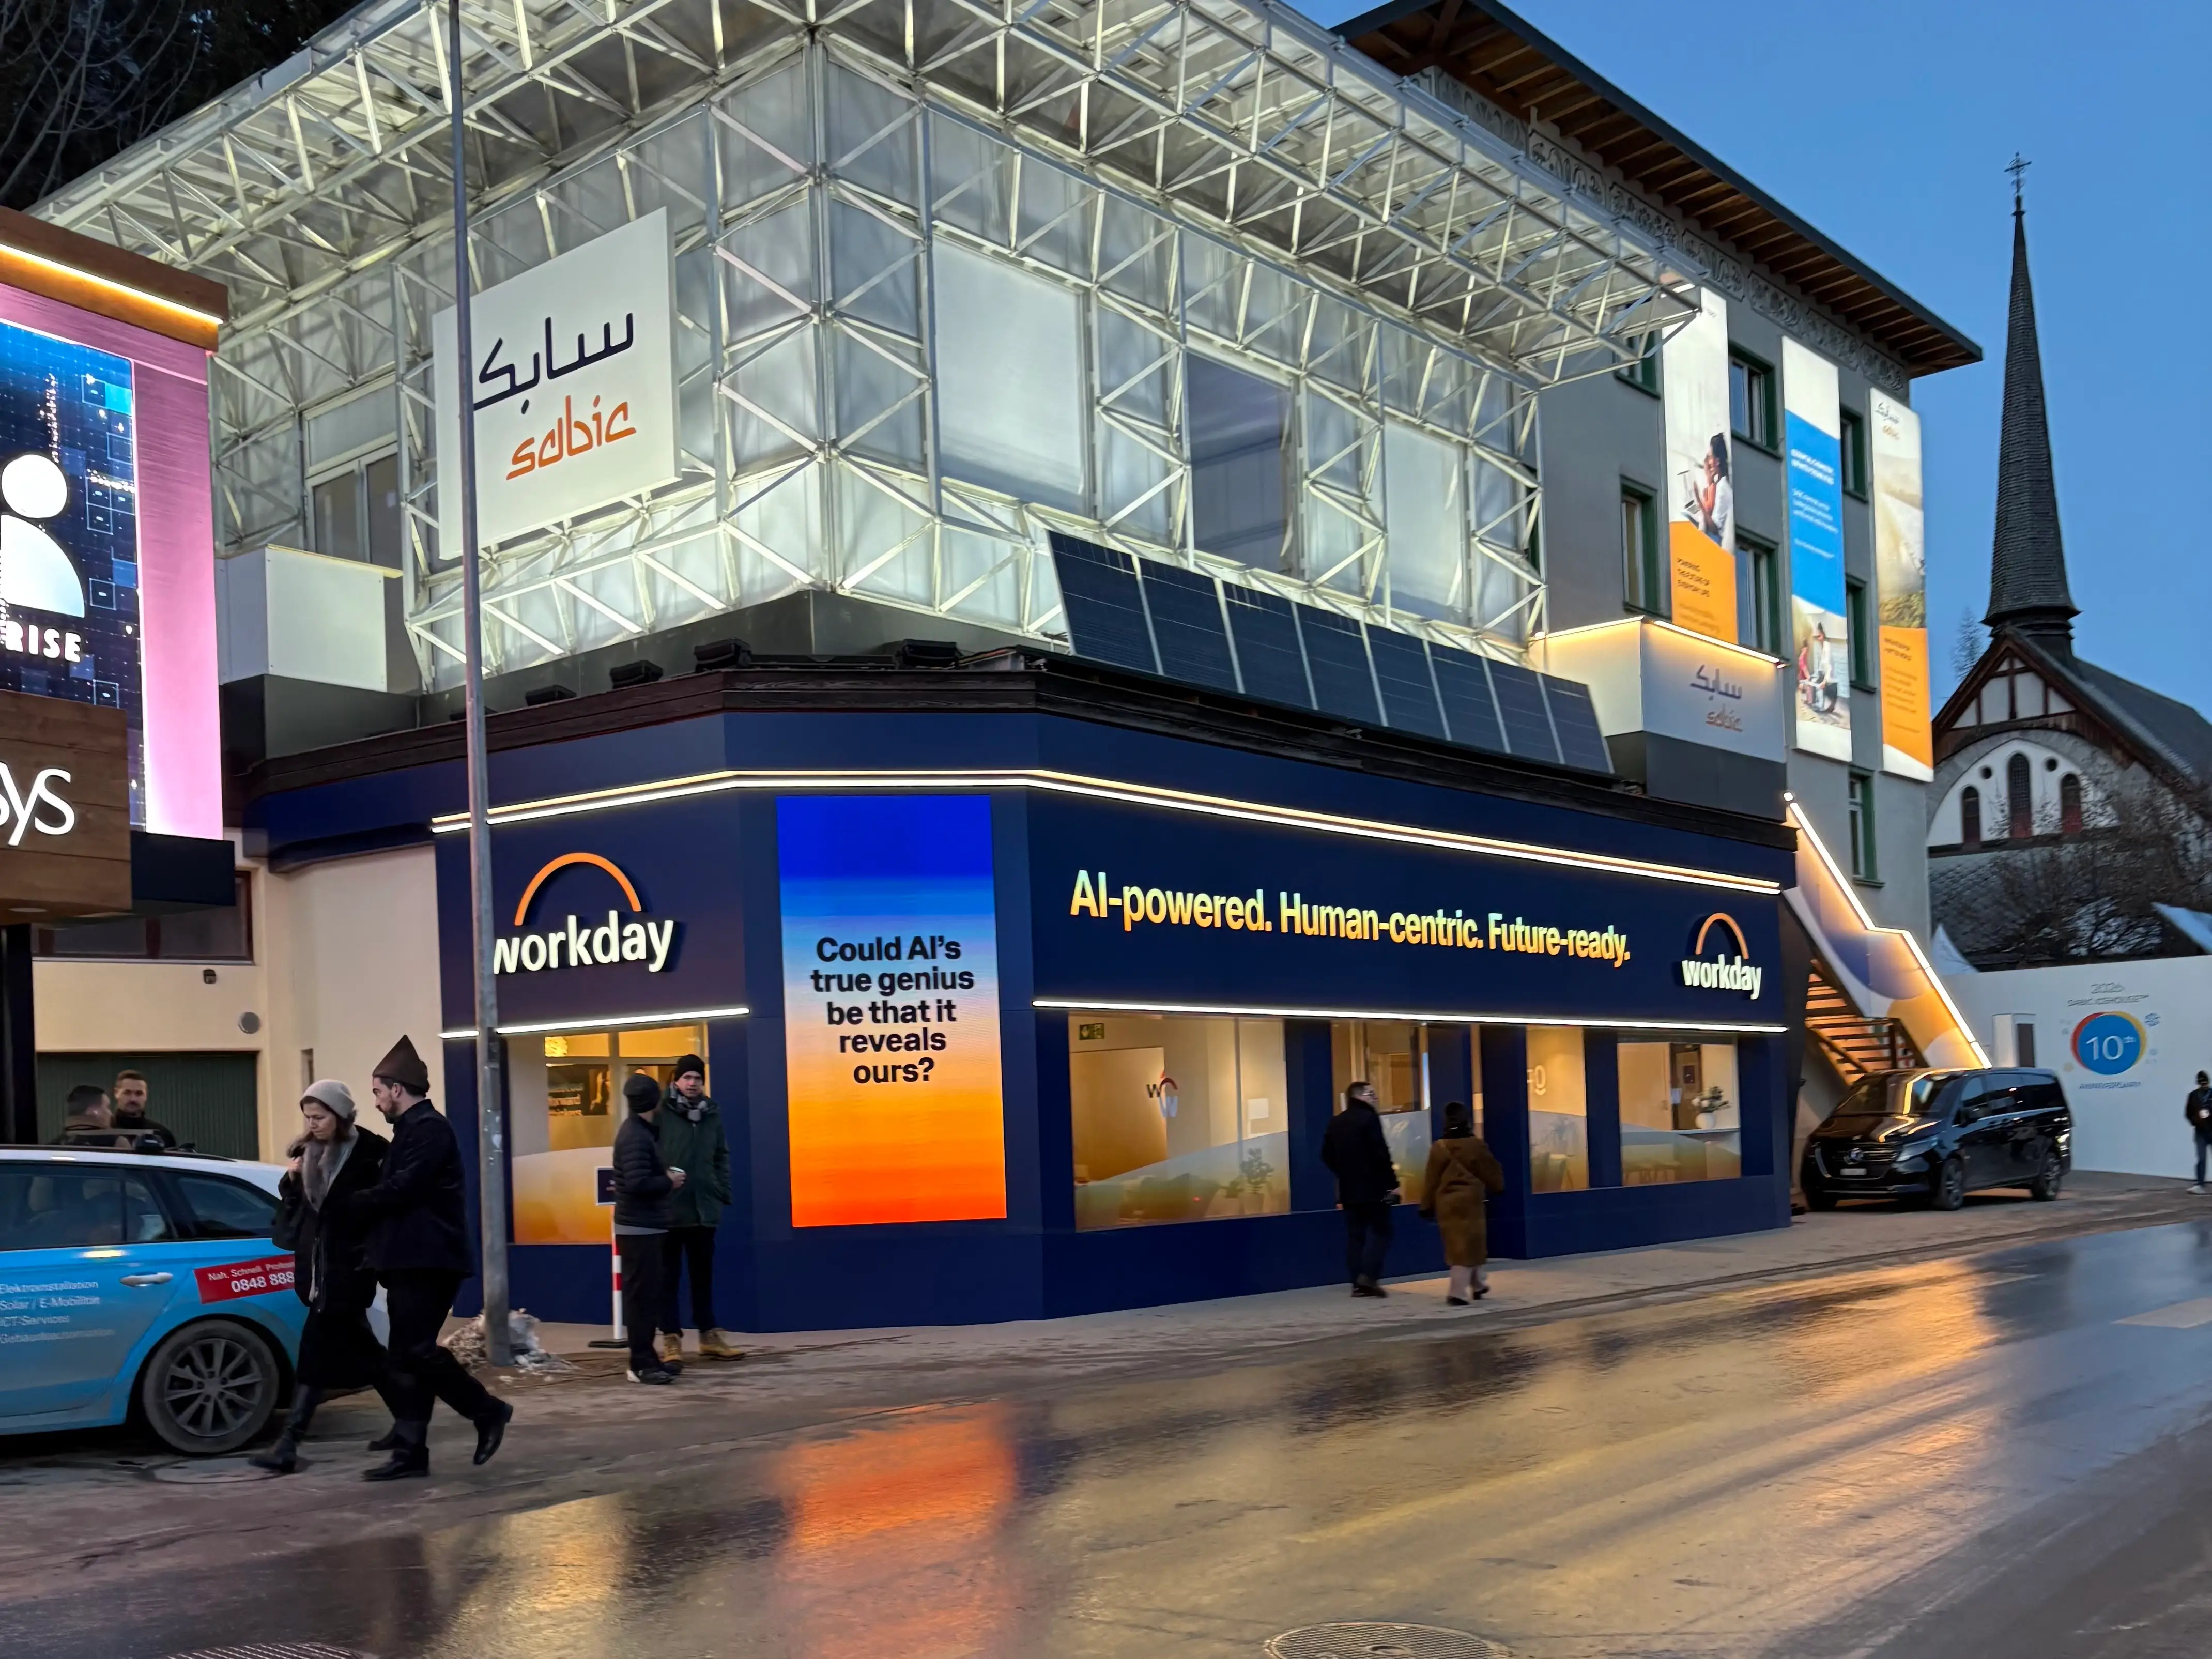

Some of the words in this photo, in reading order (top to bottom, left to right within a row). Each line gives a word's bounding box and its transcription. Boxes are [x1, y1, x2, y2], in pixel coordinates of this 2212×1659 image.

[506, 394, 637, 481] sabic
[1070, 869, 1273, 932] AI-powered.
[1280, 890, 1484, 949] Human-centric.
[1488, 912, 1631, 968] Future-ready.
[493, 910, 674, 974] workday
[817, 936, 901, 962] Could
[811, 970, 872, 992] true
[879, 966, 974, 997] genius
[1682, 954, 1762, 1000] workday
[827, 1001, 864, 1025] be
[868, 1000, 930, 1024] that
[936, 999, 956, 1022] it
[840, 1027, 946, 1053] reveals
[854, 1057, 934, 1084] ours?
[231, 1276, 267, 1293] 0848
[269, 1271, 294, 1286] 888
